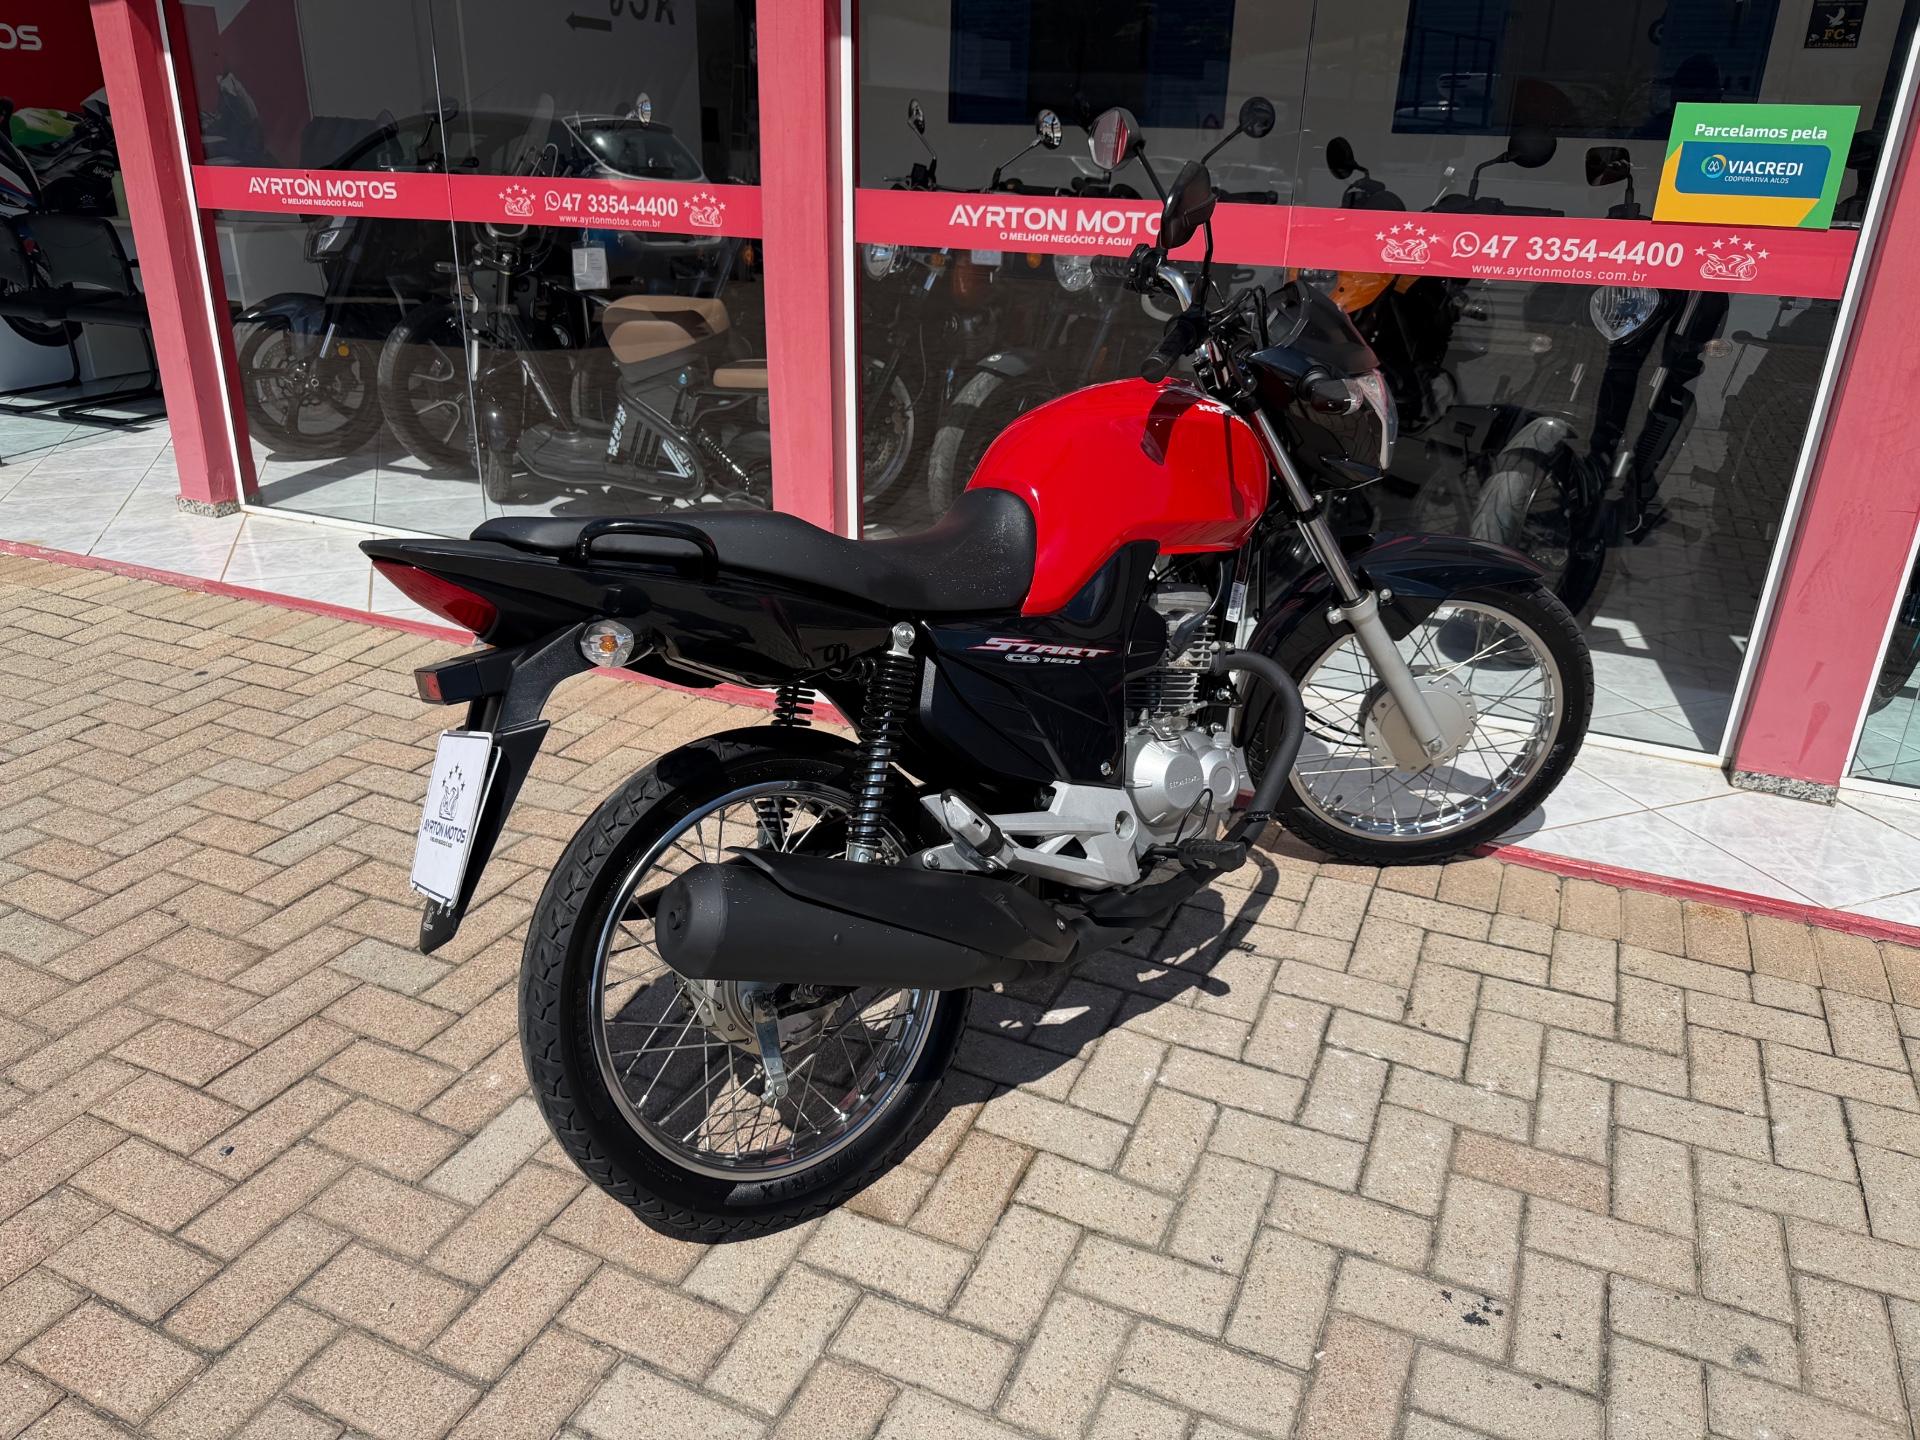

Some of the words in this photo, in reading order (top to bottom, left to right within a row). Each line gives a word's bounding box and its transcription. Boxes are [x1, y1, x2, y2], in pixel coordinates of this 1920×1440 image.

[1694, 123, 1788, 139] Parcelamos
[1790, 126, 1828, 141] pela
[1727, 160, 1804, 176] VIACREDI
[249, 176, 322, 197] AYRTON
[326, 179, 397, 200] MOTOS
[1724, 175, 1769, 184] COOPERATIVA
[281, 197, 287, 205] O
[287, 198, 313, 206] MELHOR
[313, 197, 342, 207] NEGÓCIO
[347, 200, 364, 208] AQUI
[562, 193, 582, 211] 47
[587, 194, 678, 217] 3354-4400
[559, 214, 661, 228] www.ayrtonmotos.com.br
[949, 204, 1067, 231] AYRTON
[1075, 209, 1163, 236] MOTO
[999, 231, 1008, 241] O
[1009, 232, 1049, 243] MELHOR
[1051, 232, 1096, 245] NEGÓCIO
[1097, 233, 1104, 245] É
[1106, 236, 1132, 247] AQUI
[1481, 234, 1519, 259] 47
[1525, 236, 1684, 268] 3354-4400
[1471, 263, 1648, 283] www.ayrtonmotos.com.br
[966, 637, 1116, 658] START
[1042, 656, 1081, 665] 160
[423, 819, 445, 837] AYRTON
[444, 825, 466, 843] MOTOS
